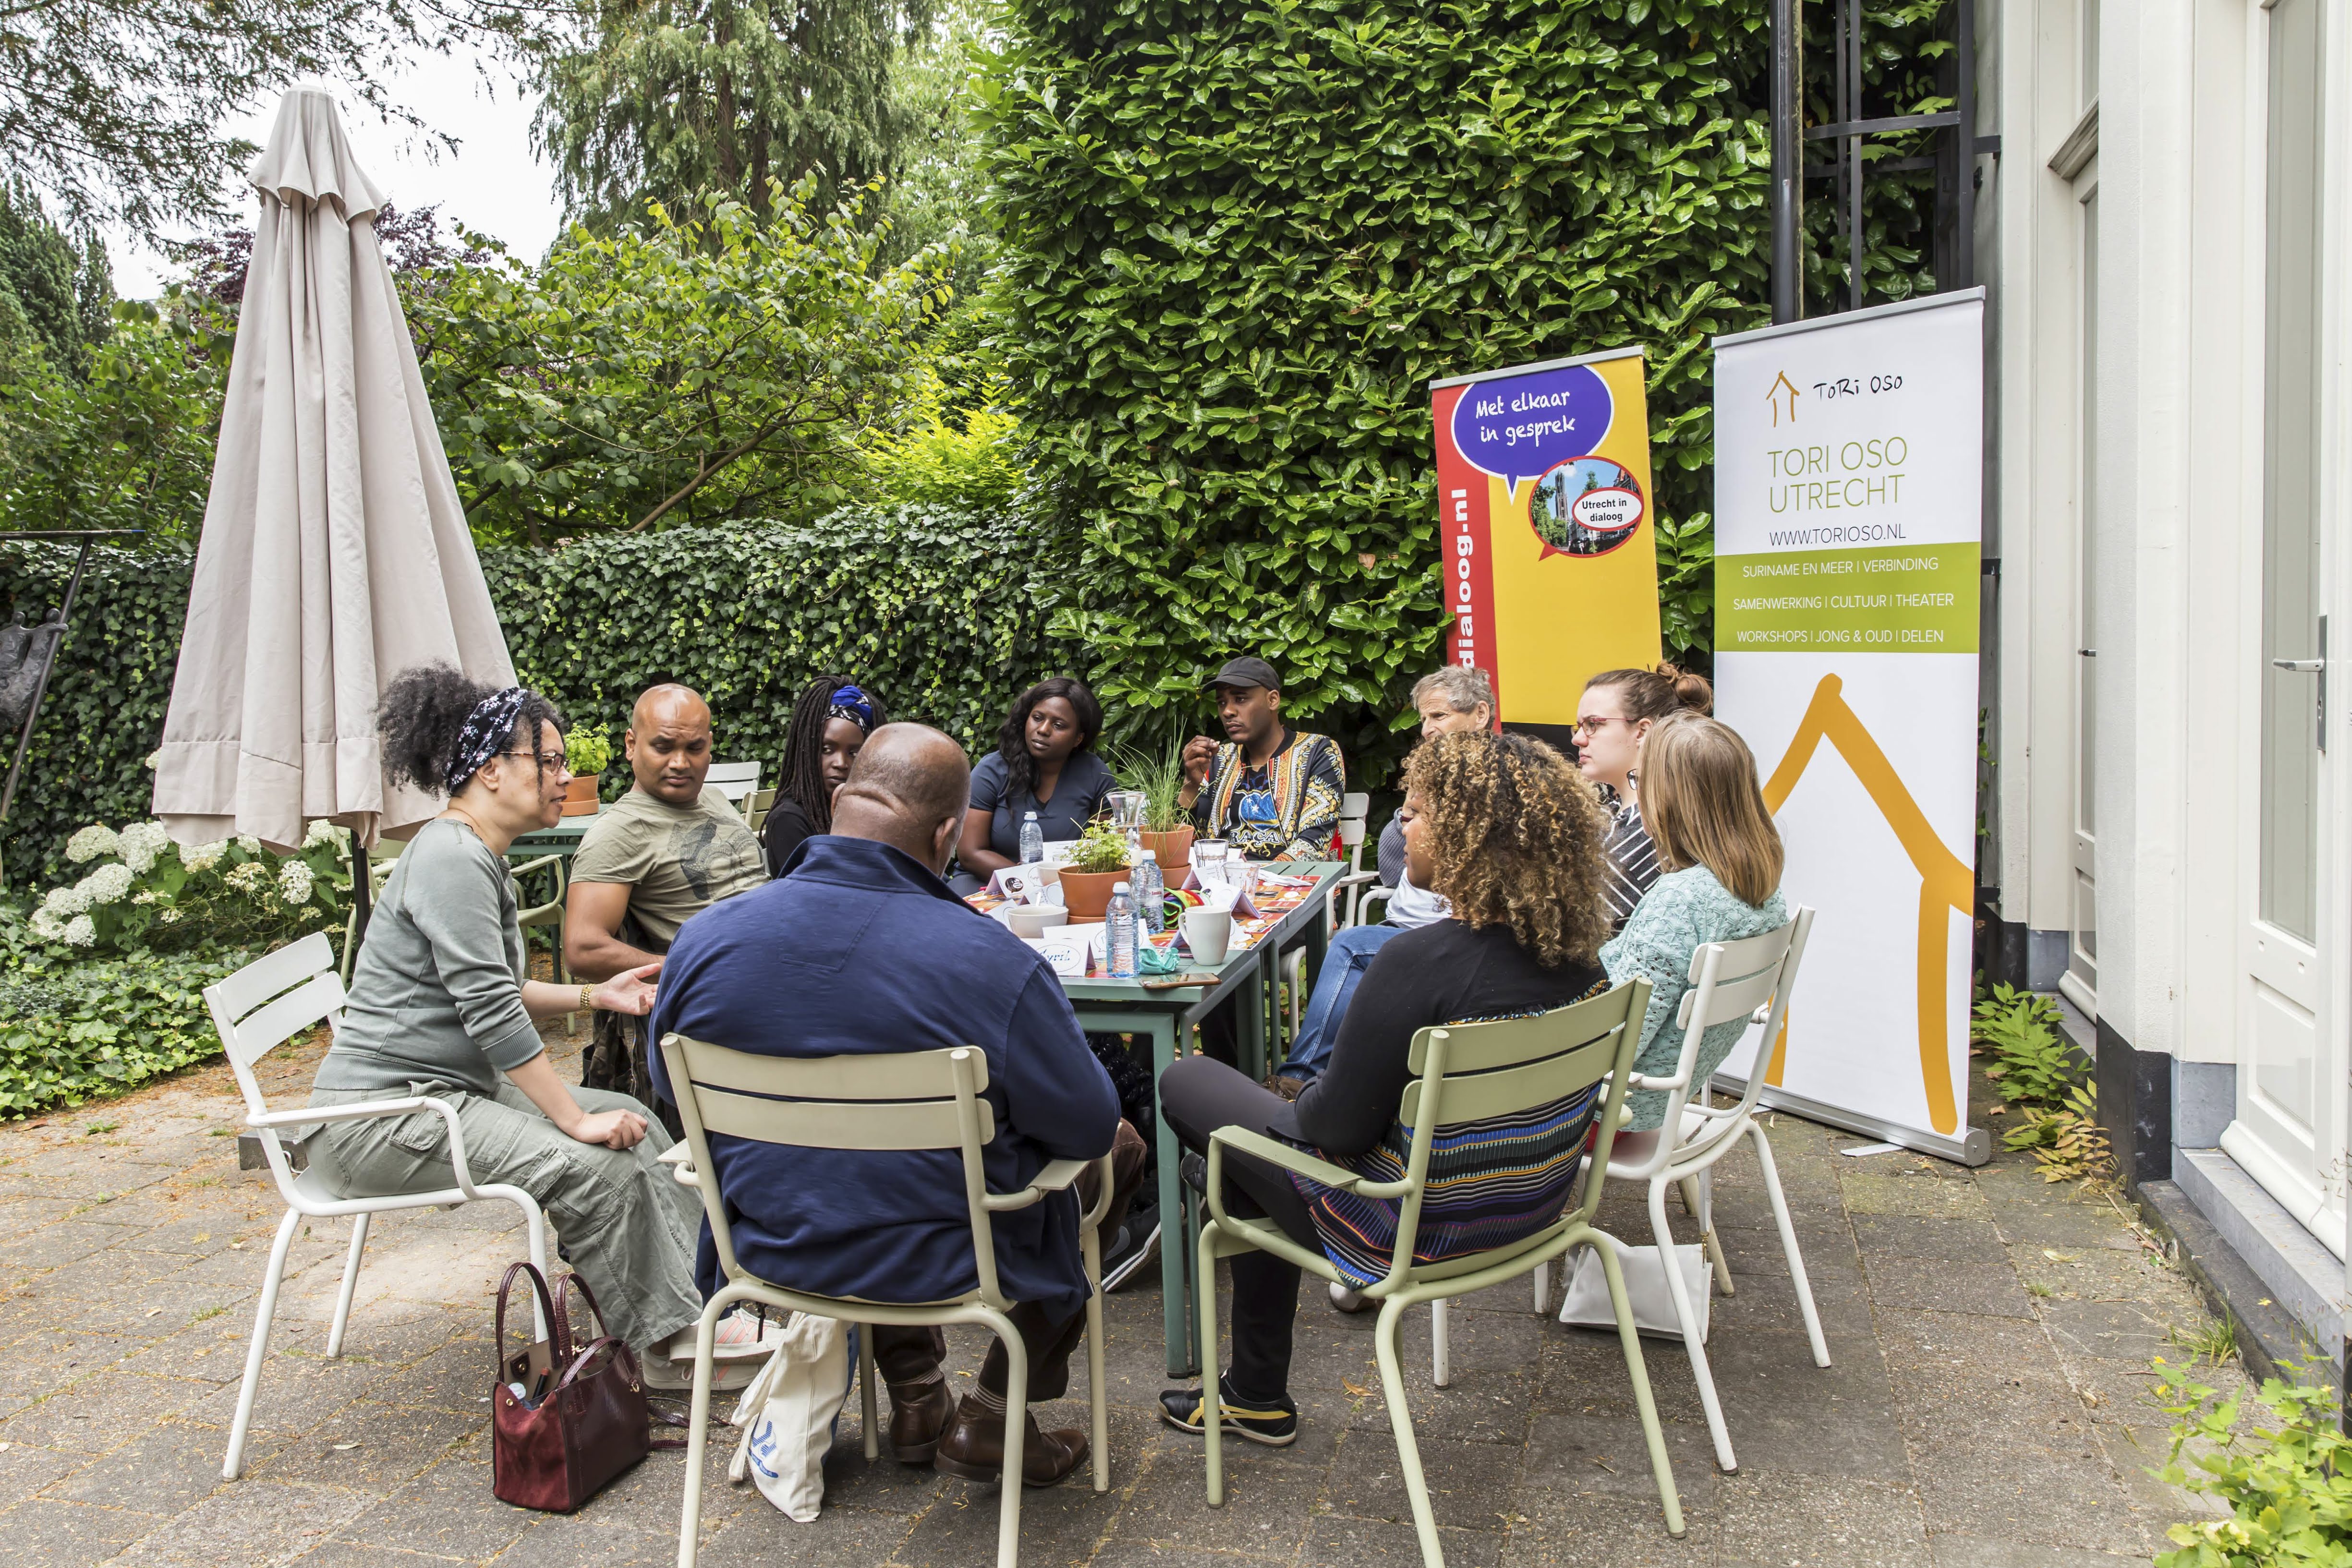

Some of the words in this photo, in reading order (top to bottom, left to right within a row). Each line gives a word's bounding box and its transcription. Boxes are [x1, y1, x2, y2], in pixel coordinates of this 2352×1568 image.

[1476, 396, 1504, 419] Met
[1511, 390, 1571, 412] elkaar
[1480, 425, 1499, 442] in
[1505, 415, 1576, 447] gesprek
[1767, 445, 1829, 478] TORI
[1841, 436, 1908, 471] OSO
[1581, 498, 1616, 509] Utrecht
[1618, 498, 1627, 507] in
[1770, 473, 1905, 514] UTRECHT
[1589, 511, 1623, 522] dialoog
[1770, 523, 1906, 546] WWW.TORIOSO.NL
[1451, 489, 1475, 669] dialoog.nl
[1743, 564, 1800, 578] SURINAME
[1803, 563, 1818, 575] EN
[1820, 561, 1853, 574] MEER
[1863, 557, 1939, 573] VERBINDING
[1733, 596, 1822, 611] SAMENWERKING
[1831, 595, 1887, 609] CULTUUR
[1896, 592, 1954, 607] THEATER
[1737, 630, 1808, 643] WORKSHOPS
[1815, 630, 1851, 643] JONG
[1853, 631, 1862, 642] &
[1866, 630, 1893, 642] OUD
[1902, 629, 1944, 642] DELEN
